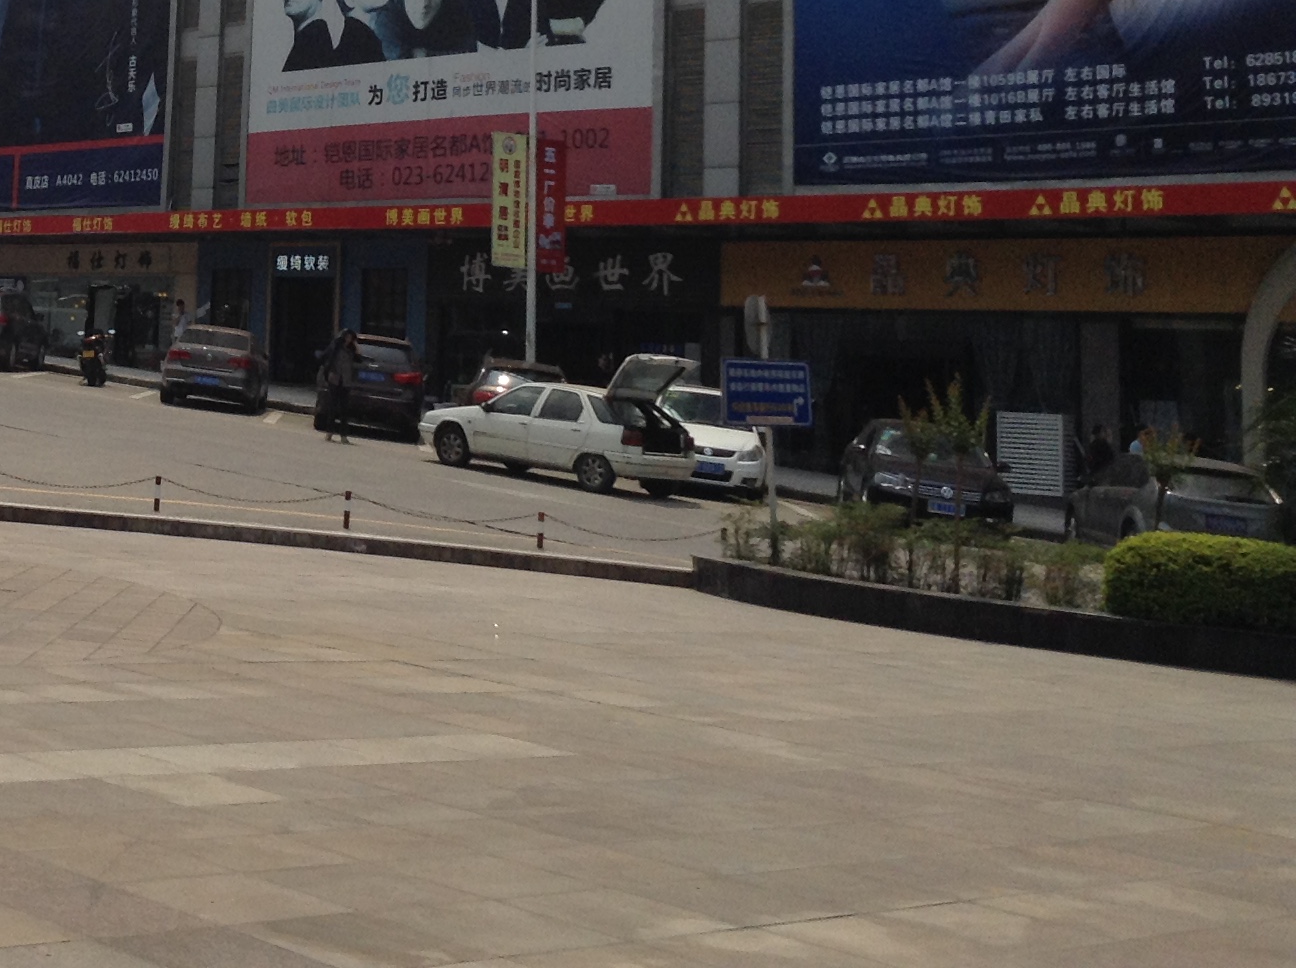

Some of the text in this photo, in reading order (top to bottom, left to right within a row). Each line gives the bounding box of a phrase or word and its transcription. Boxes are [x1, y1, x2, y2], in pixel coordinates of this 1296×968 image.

[536, 66, 613, 93] 时尚家居
[1064, 63, 1127, 82] 左右国际
[698, 199, 781, 221] 晶典灯饰
[889, 194, 983, 218] 晶典灯饰
[1058, 188, 1165, 214] 晶典灯饰
